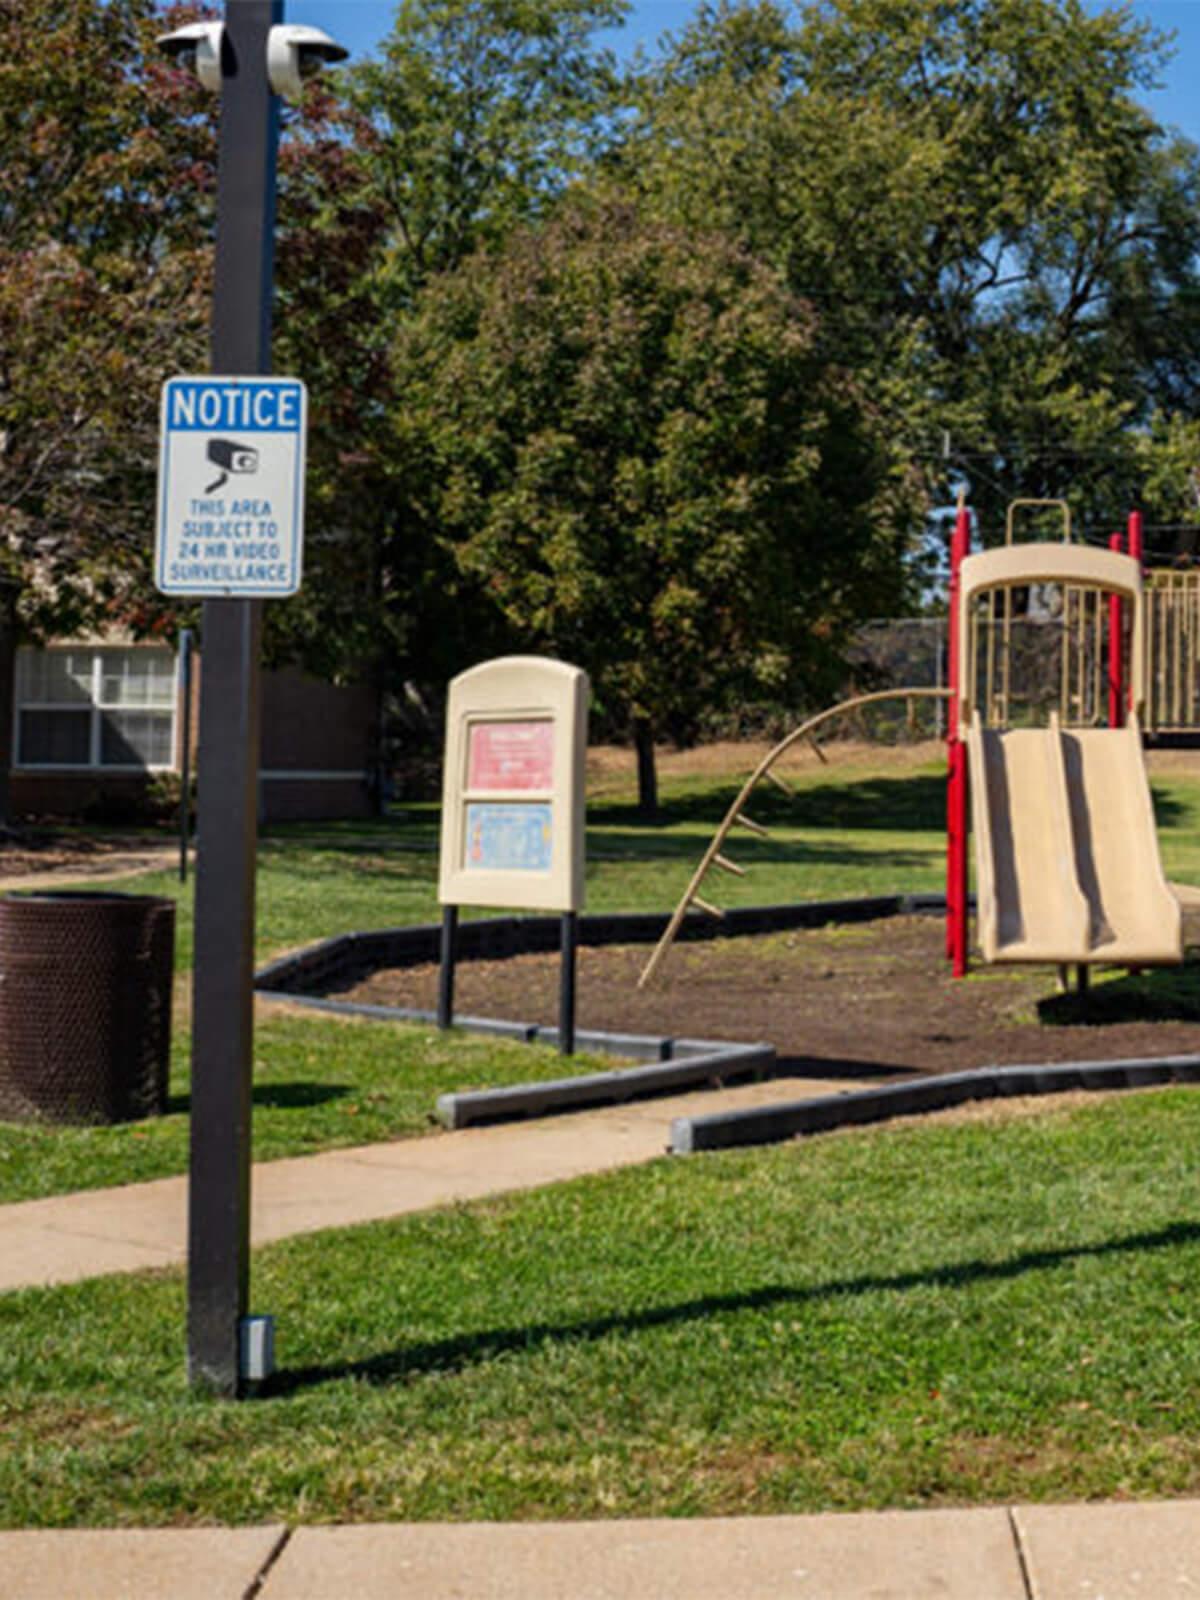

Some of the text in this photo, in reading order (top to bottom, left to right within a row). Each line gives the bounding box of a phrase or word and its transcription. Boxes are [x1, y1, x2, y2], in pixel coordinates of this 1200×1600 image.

[172, 388, 298, 427] NOTICE
[190, 500, 272, 516] THIS AREA
[182, 521, 278, 538] SUBJECT TO
[178, 543, 280, 559] 24 HR VIDEO
[170, 563, 287, 581] SURVEILLANCE
